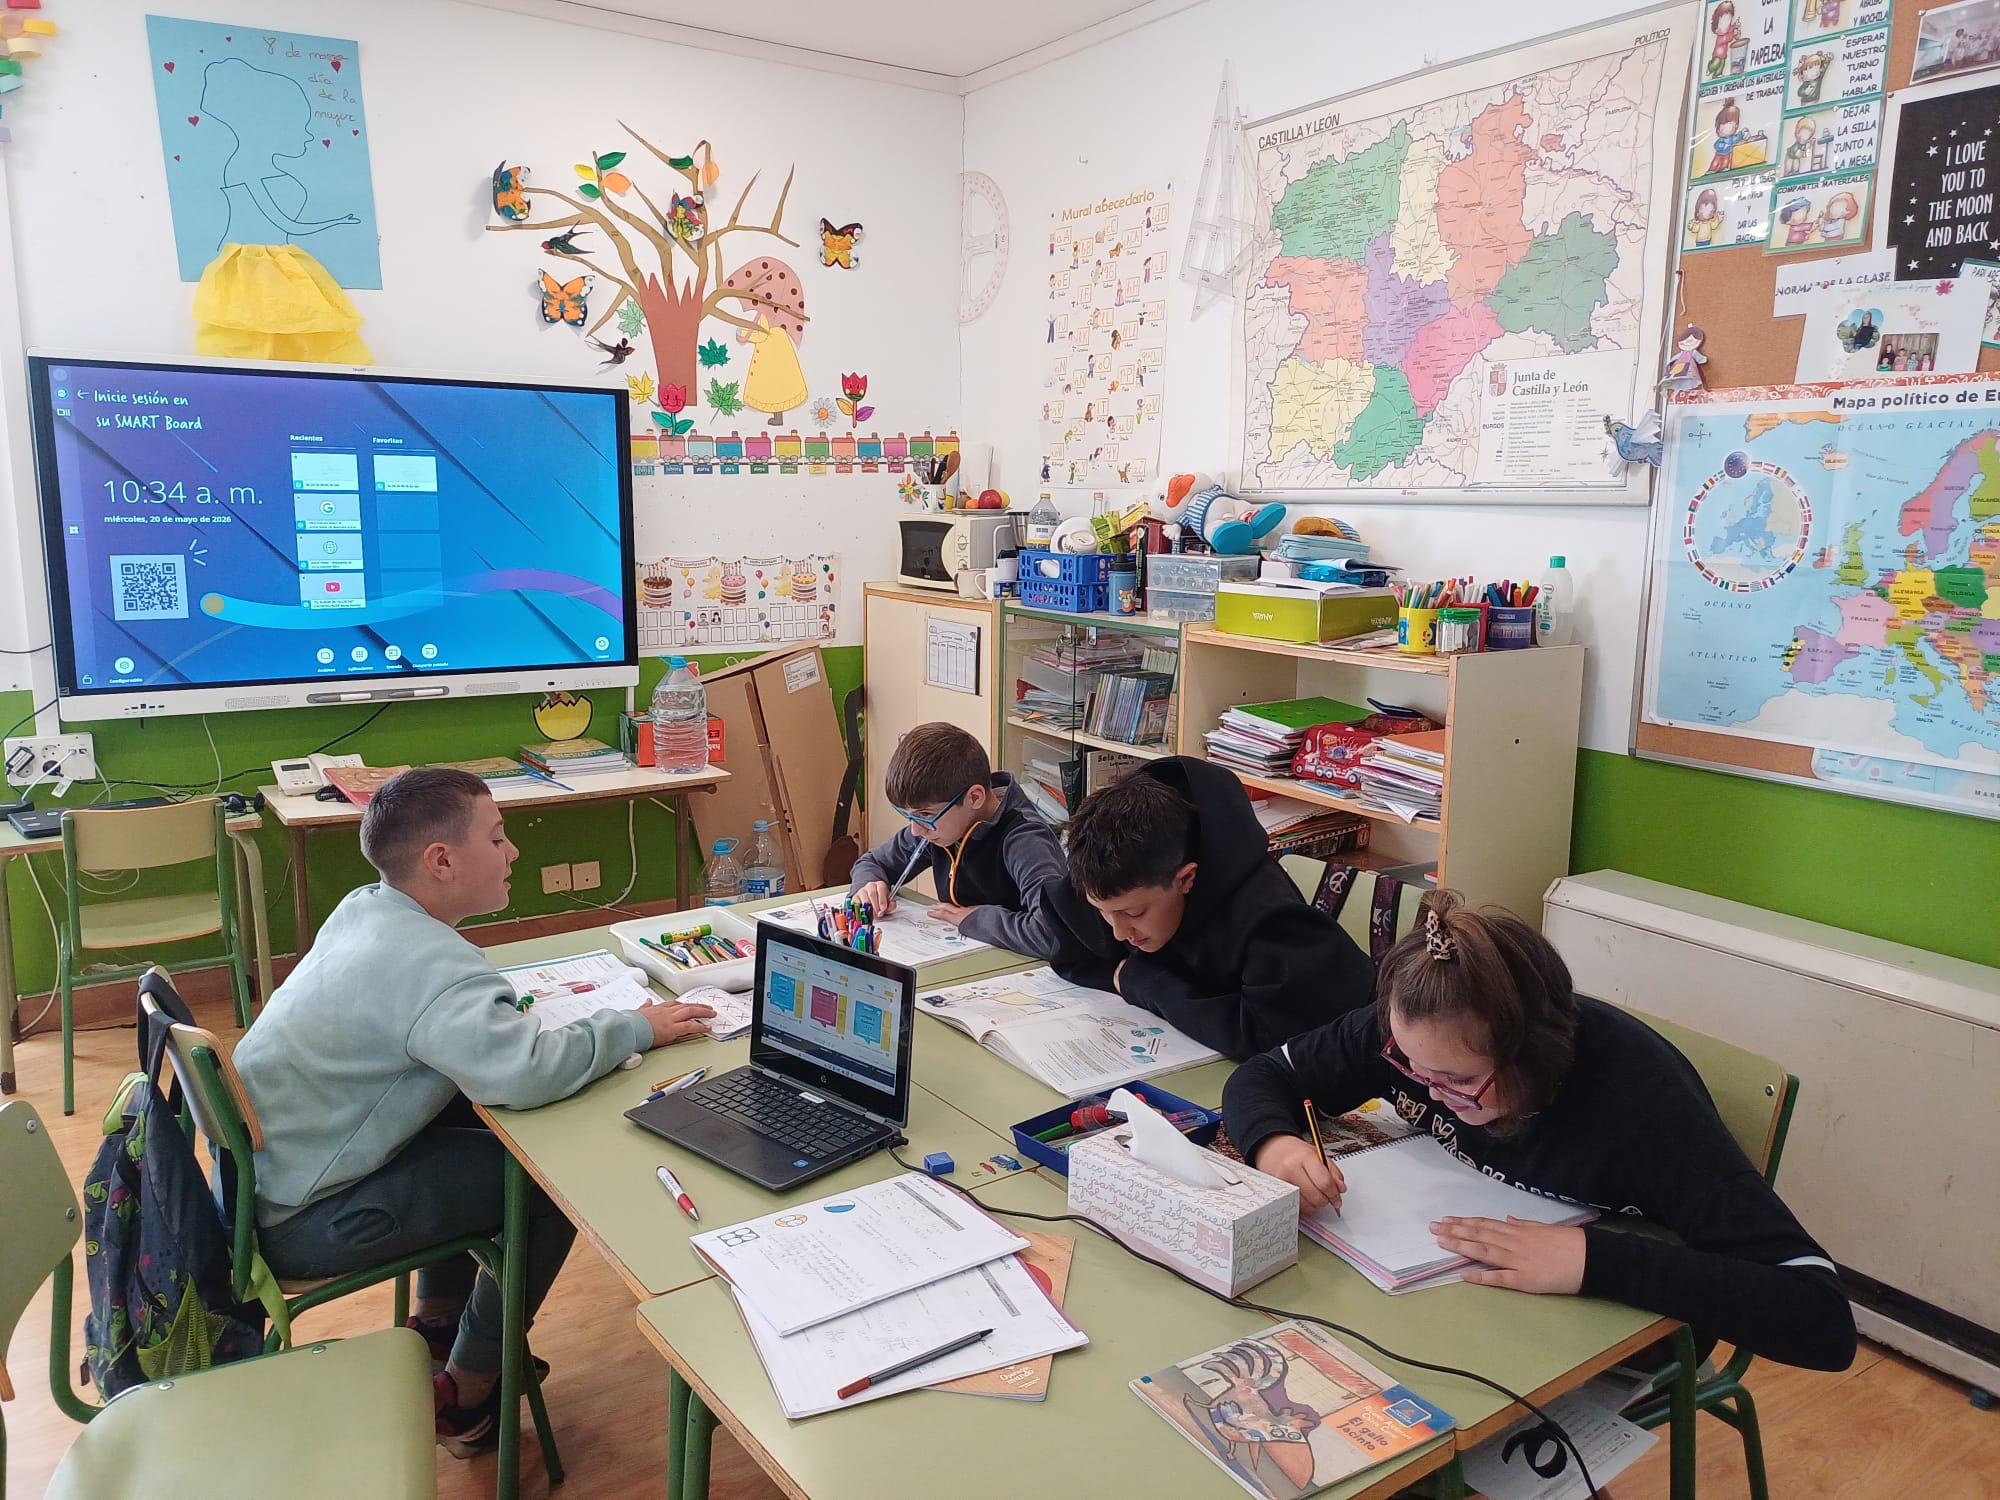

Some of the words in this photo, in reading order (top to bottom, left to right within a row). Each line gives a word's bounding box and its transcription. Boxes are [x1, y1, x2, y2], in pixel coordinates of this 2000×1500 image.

[1763, 16, 1774, 35] LA
[1859, 11, 1888, 24] MOCHILA
[262, 36, 277, 55] 8
[285, 40, 302, 58] de
[1846, 32, 1885, 48] ESPERAR
[1750, 43, 1786, 66] PAPELERA
[1842, 45, 1886, 61] NUESTRO
[1847, 58, 1880, 72] TURNO
[1849, 73, 1873, 84] PARA
[1746, 91, 1754, 101] DE
[1756, 85, 1784, 98] TRABAJO
[1842, 84, 1878, 97] HABLAR
[1843, 103, 1870, 119] DEJAR
[1258, 125, 1304, 149] CASTILLA
[1305, 121, 1313, 135] Y
[1313, 112, 1341, 133] LEÓN
[1837, 126, 1848, 137] LA
[1851, 120, 1877, 134] SILLA
[1834, 138, 1864, 154] JUNTO
[1867, 137, 1873, 147] A
[1945, 146, 1952, 167] I
[1954, 140, 1987, 165] LOVE
[1835, 159, 1846, 170] LA
[1848, 154, 1873, 167] MESA
[1778, 182, 1819, 195] COMPARTIR
[1821, 174, 1870, 188] MATERIALES
[1941, 170, 1966, 194] YOU
[1970, 167, 1986, 189] TO
[1061, 204, 1092, 222] Mural
[1094, 189, 1155, 214] abecedario
[1928, 199, 1953, 222] THE
[1955, 193, 1994, 218] MOON
[1925, 225, 1952, 248] AND
[1955, 221, 1990, 244] BACK
[1838, 277, 1853, 285] LA
[1856, 271, 1891, 284] CLASE
[1512, 371, 1540, 386] Junta
[1543, 369, 1556, 380] de
[94, 389, 128, 403] Inicie
[132, 389, 169, 405] sesión
[173, 396, 189, 406] en
[1512, 384, 1551, 398] Castilla
[1553, 385, 1561, 397] y
[1563, 380, 1589, 394] León
[1833, 397, 1875, 410] Mapa
[1881, 391, 1950, 409] político
[1955, 390, 1979, 403] de
[96, 416, 111, 428] su
[115, 413, 160, 429] SMART
[164, 415, 203, 431] Board
[1905, 420, 1976, 430] GLACIAL
[290, 434, 323, 442] Recientes
[103, 480, 187, 504] 10:34
[196, 486, 220, 504] a.
[229, 486, 264, 505] m.
[104, 515, 149, 524] miércoles,
[162, 515, 173, 523] de
[174, 517, 198, 525] mayo
[200, 515, 210, 523] de
[1336, 1422, 1376, 1451] Jacinto
[1347, 1416, 1364, 1428] El
[1360, 1425, 1389, 1447] gallo
